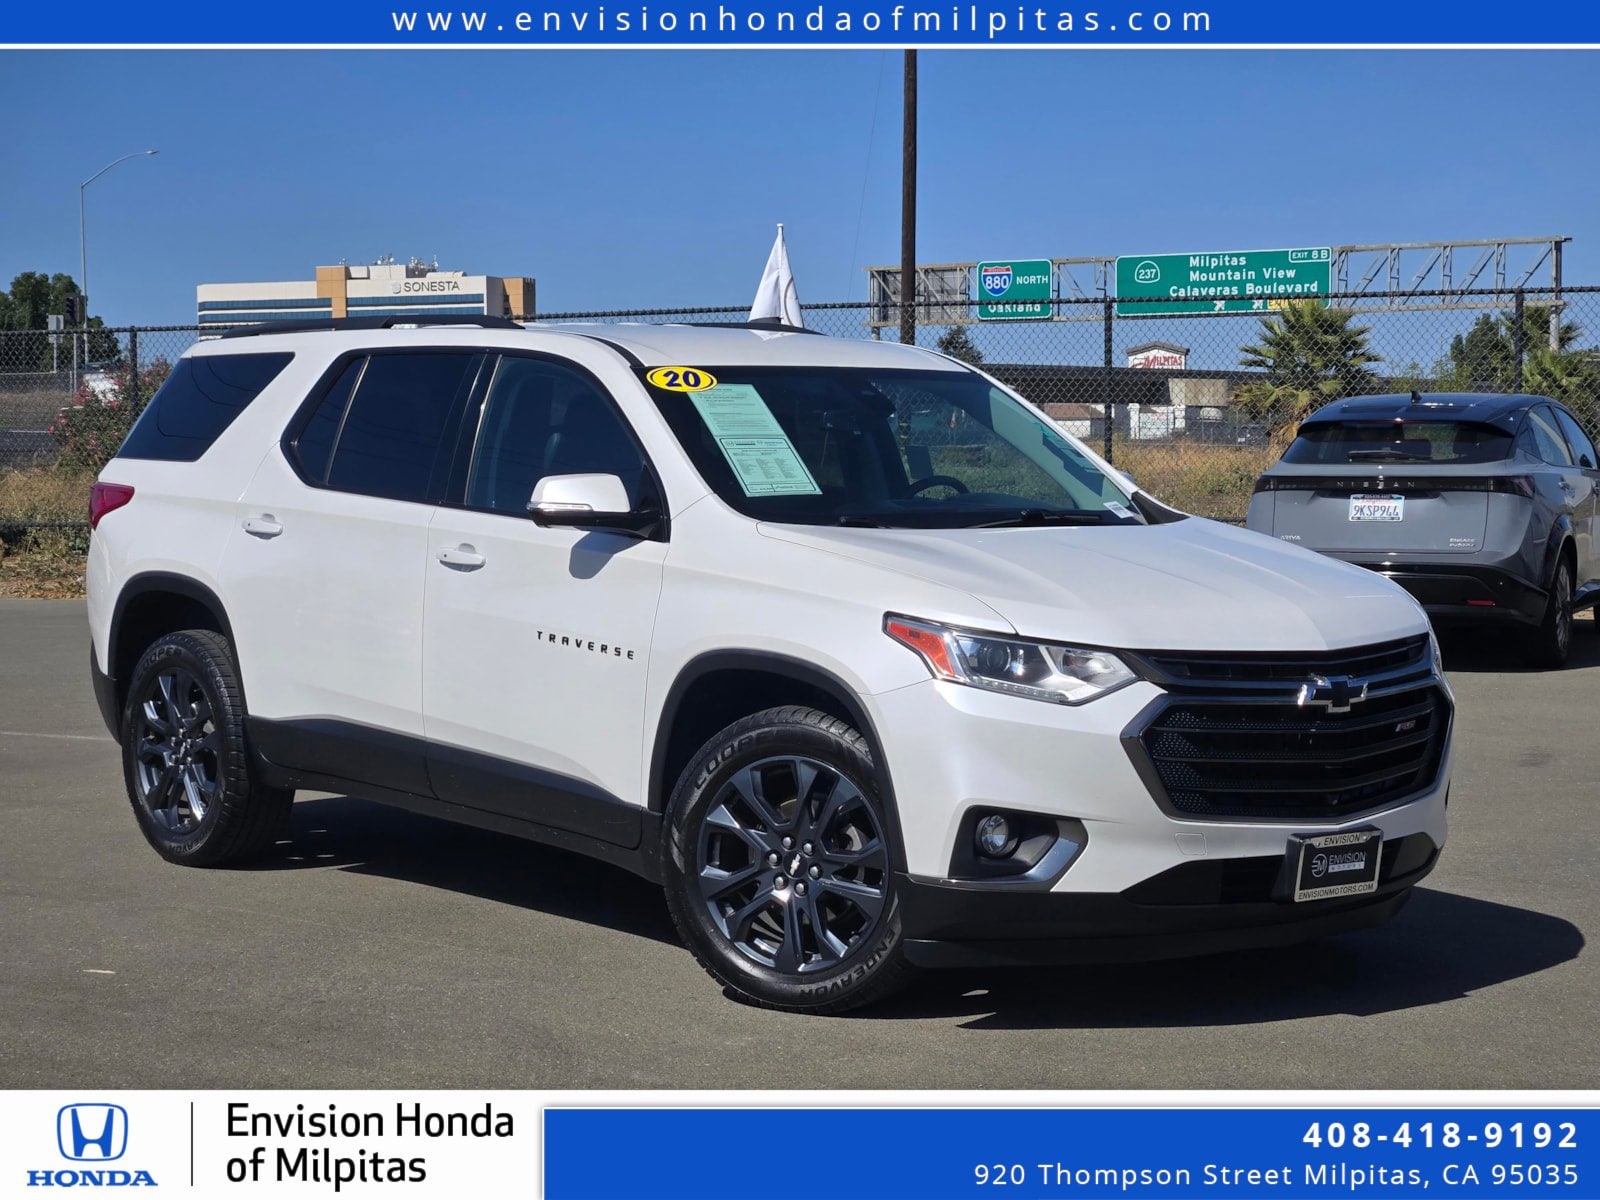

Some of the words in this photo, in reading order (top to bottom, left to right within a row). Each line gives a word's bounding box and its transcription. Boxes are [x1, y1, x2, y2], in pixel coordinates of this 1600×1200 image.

[1189, 254, 1247, 269] Milpitas
[1292, 251, 1308, 259] EXIT
[1016, 275, 1049, 285] NORTH
[1138, 268, 1156, 280] 237
[1189, 268, 1256, 282] Mountain
[1262, 267, 1296, 279] View
[403, 280, 460, 293] SONESTA
[985, 275, 1009, 290] 880
[1169, 284, 1239, 297] Calaveras
[1245, 280, 1318, 295] Boulevard
[662, 370, 701, 388] 20
[1336, 480, 1416, 489] NISSAN
[1353, 504, 1399, 517] 9KSP944
[536, 630, 635, 660] TRAVERSE
[1323, 834, 1360, 846] ENVISION
[1329, 851, 1366, 865] ENVISION
[1298, 883, 1374, 900] ENVISIONMOTORS.COM
[799, 928, 897, 998] ENDEAVOR
